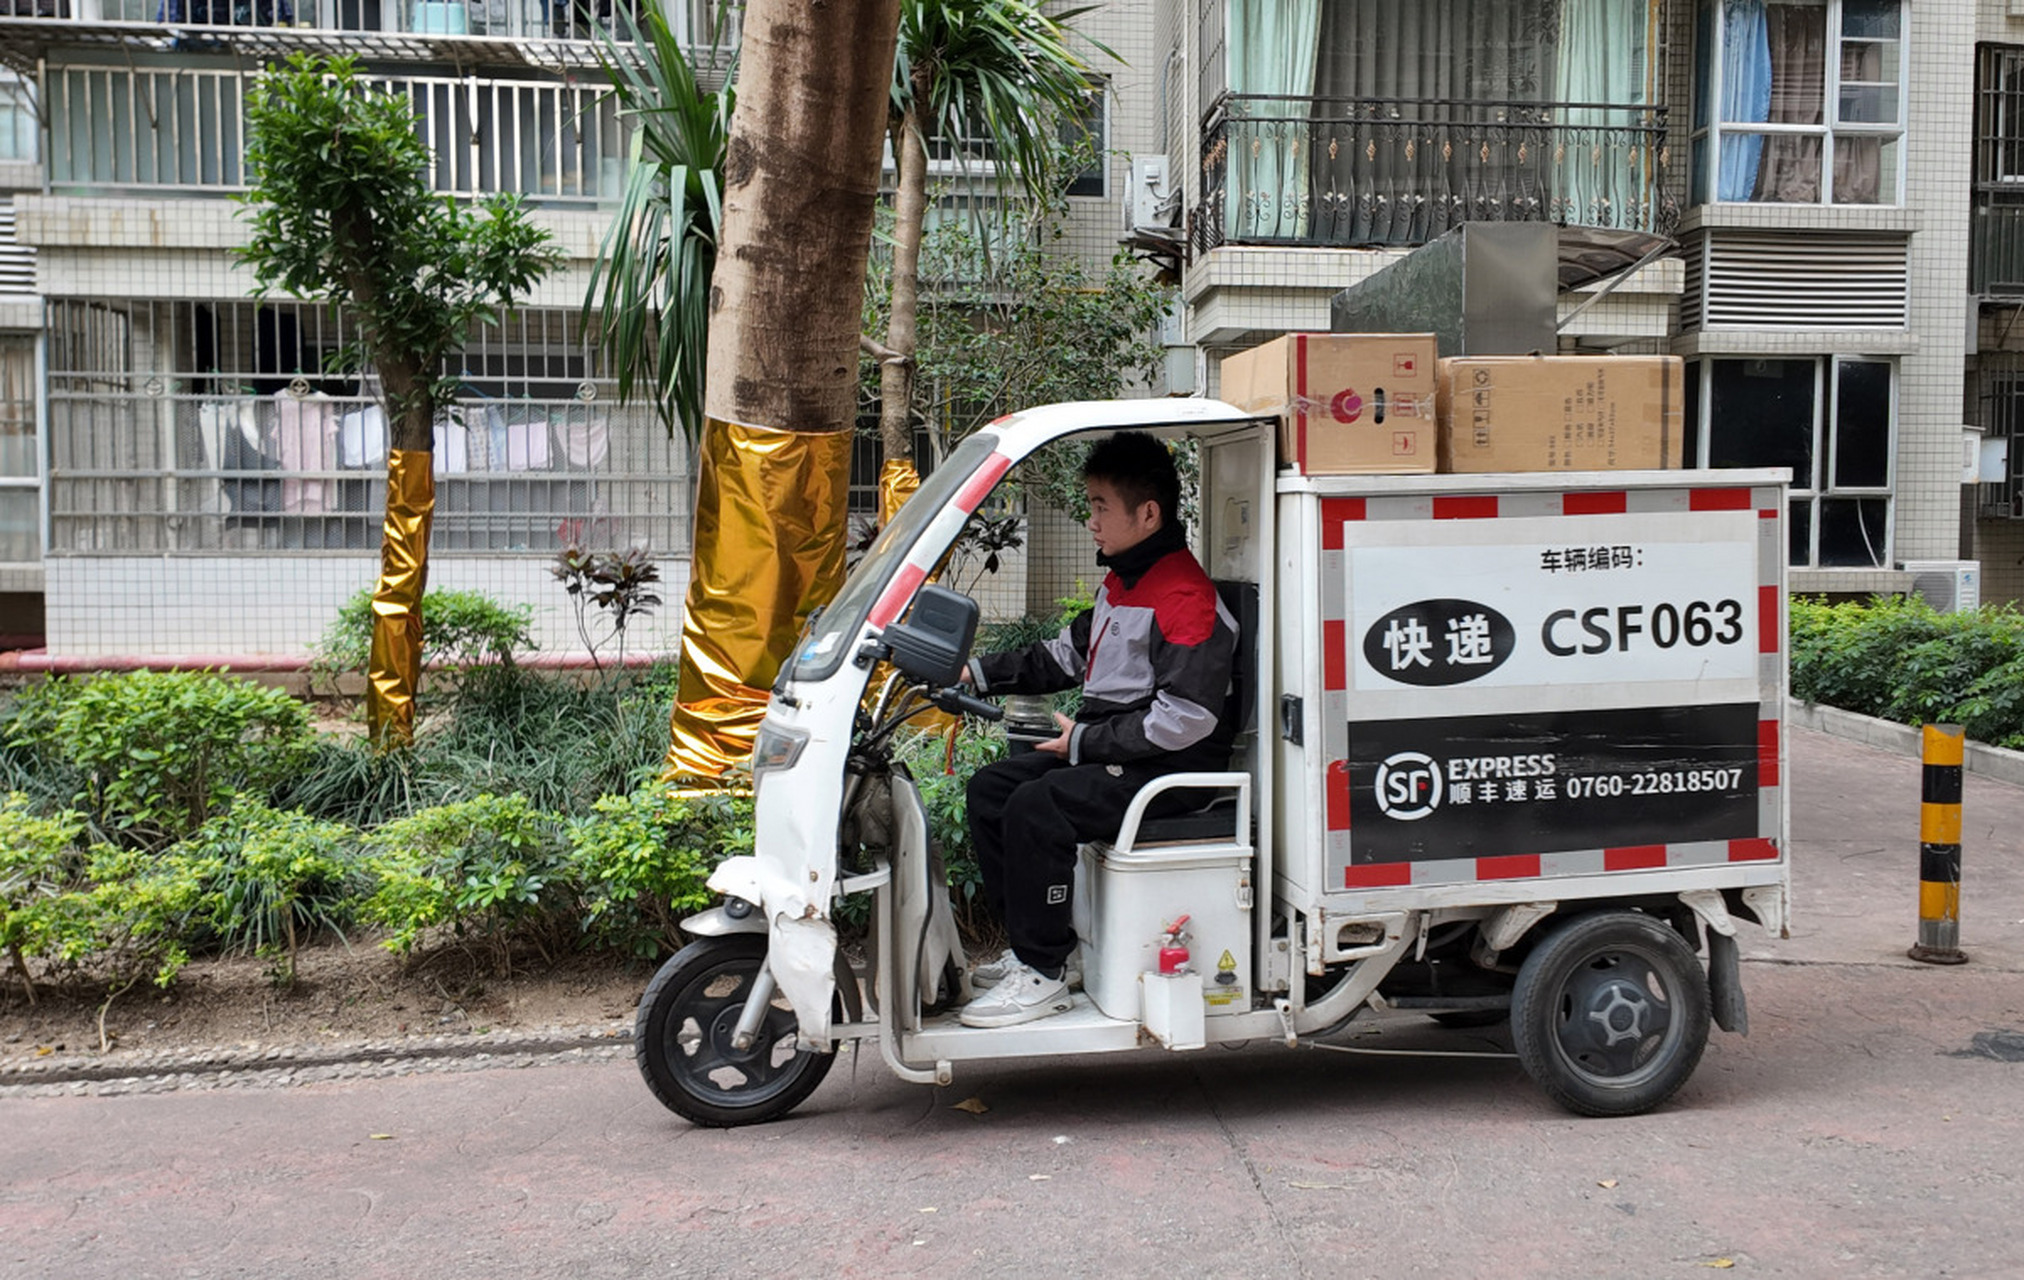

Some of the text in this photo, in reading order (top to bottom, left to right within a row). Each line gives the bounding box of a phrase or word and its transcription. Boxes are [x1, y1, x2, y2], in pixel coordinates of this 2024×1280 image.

[1382, 613, 1494, 670] 快递
[1541, 599, 1743, 657] CSF063
[1448, 754, 1556, 781] EXPRESS
[1448, 767, 1742, 804] 顺丰速运 0760-22818507
